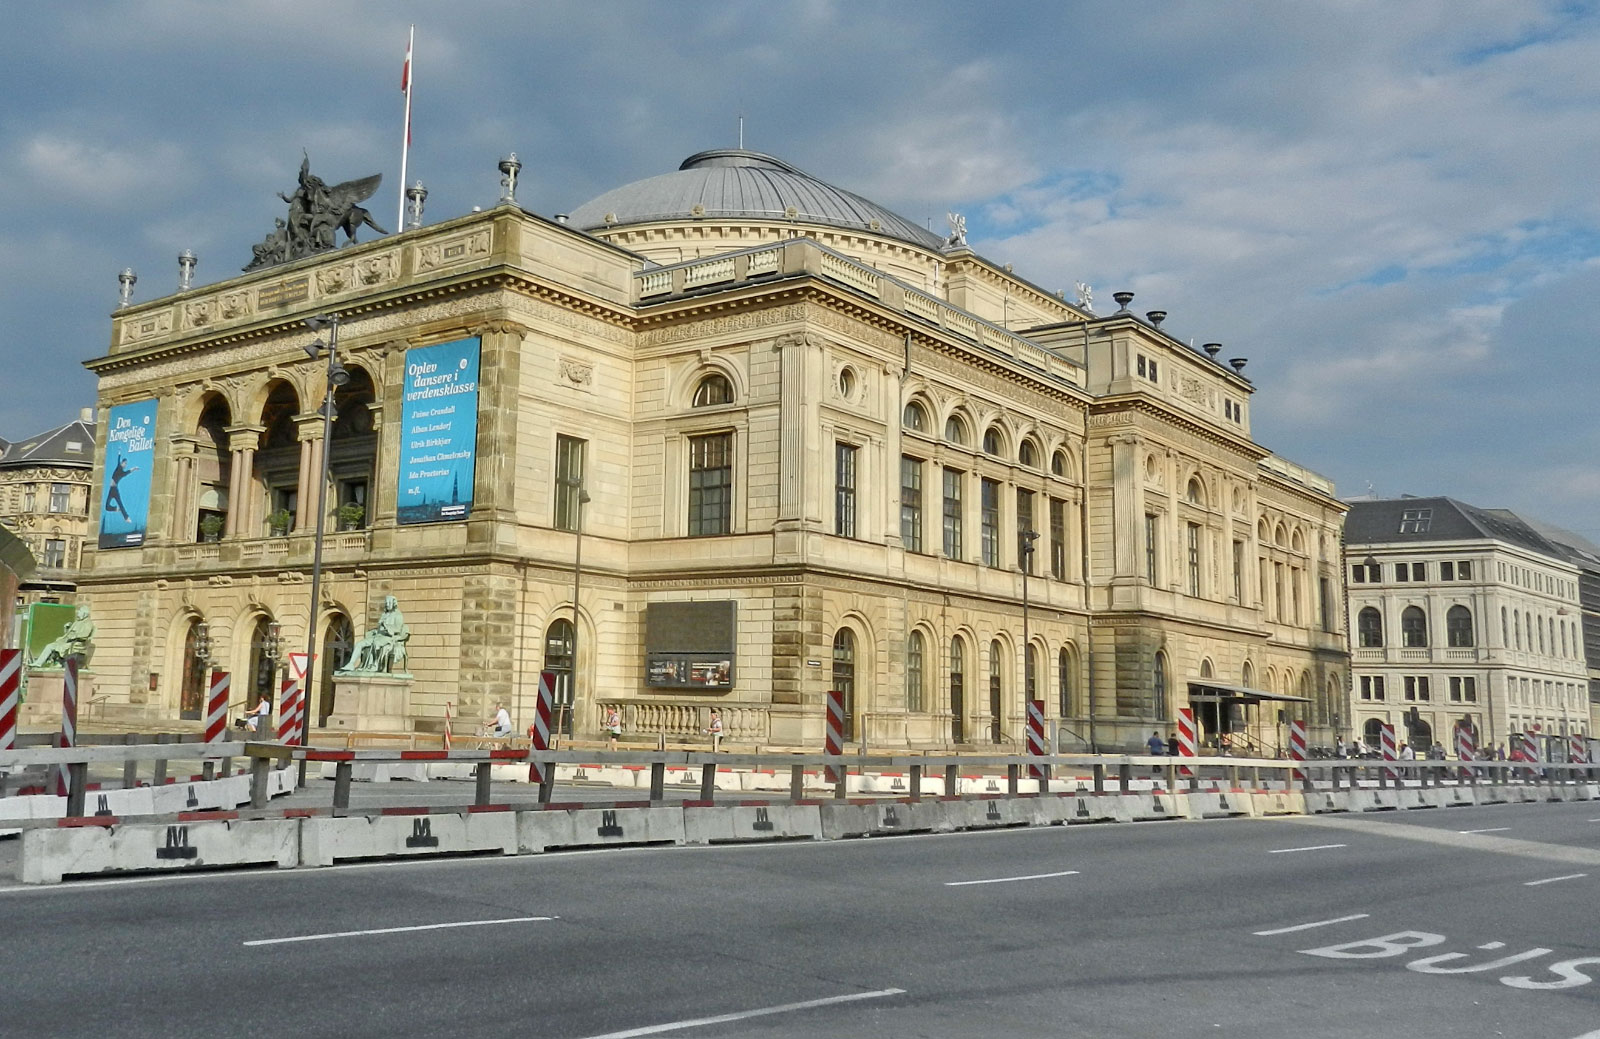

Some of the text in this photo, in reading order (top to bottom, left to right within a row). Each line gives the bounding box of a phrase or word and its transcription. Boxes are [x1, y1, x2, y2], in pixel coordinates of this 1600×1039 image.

[409, 362, 437, 377] Oplev
[414, 369, 459, 388] dansere i
[407, 382, 475, 401] verdensklasse
[116, 417, 131, 429] Den
[109, 426, 145, 442] Kongelige
[128, 437, 153, 453] Ballet
[1296, 930, 1600, 990] BUS
